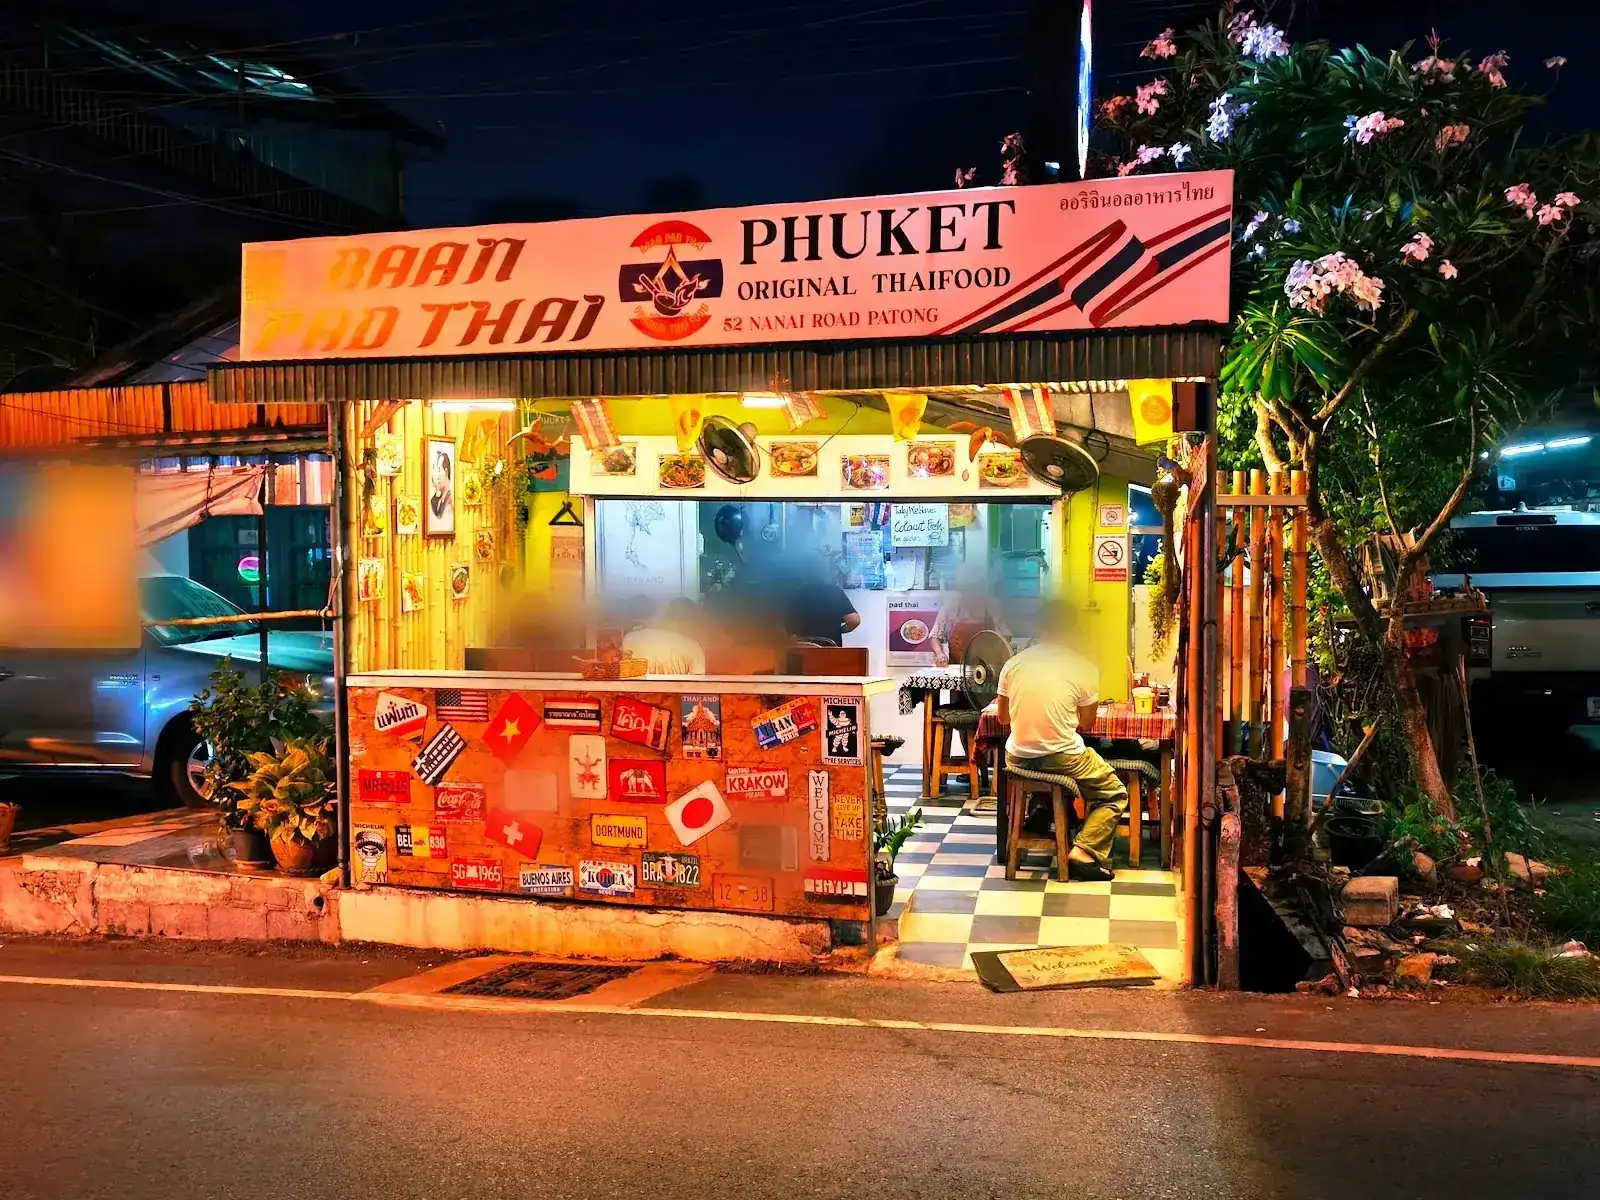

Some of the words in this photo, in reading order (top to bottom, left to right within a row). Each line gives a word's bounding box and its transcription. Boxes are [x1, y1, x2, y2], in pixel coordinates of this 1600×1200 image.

[1060, 181, 1214, 210] ออริจินอลอาหารไทย
[740, 200, 1015, 265] PHUKET
[324, 238, 527, 290] BAAN
[738, 276, 856, 300] ORIGINAL
[872, 267, 1010, 293] THAIFOOD
[255, 306, 400, 353] PAD
[416, 294, 605, 348] THAI
[723, 317, 743, 332] 52
[750, 315, 804, 332] NANAI
[812, 311, 860, 328] ROAD
[868, 308, 938, 325] PATONG
[829, 725, 856, 736] MICHELIN
[729, 775, 785, 791] KRAKOW
[834, 796, 861, 804] NEVER
[813, 776, 824, 854] WELCOME
[836, 818, 862, 828] TAKE
[596, 824, 642, 839] DORTMUND
[836, 829, 862, 840] TIME
[397, 834, 412, 847] BEL
[452, 863, 465, 879] SG
[478, 864, 501, 881] 1965
[522, 872, 550, 886] BUENOS
[551, 871, 571, 885] AIRES
[588, 870, 625, 886] KOREA
[643, 861, 663, 882] BRA
[720, 884, 731, 900] 12
[814, 880, 855, 896] EGYPT
[1033, 959, 1107, 971] Welcome
